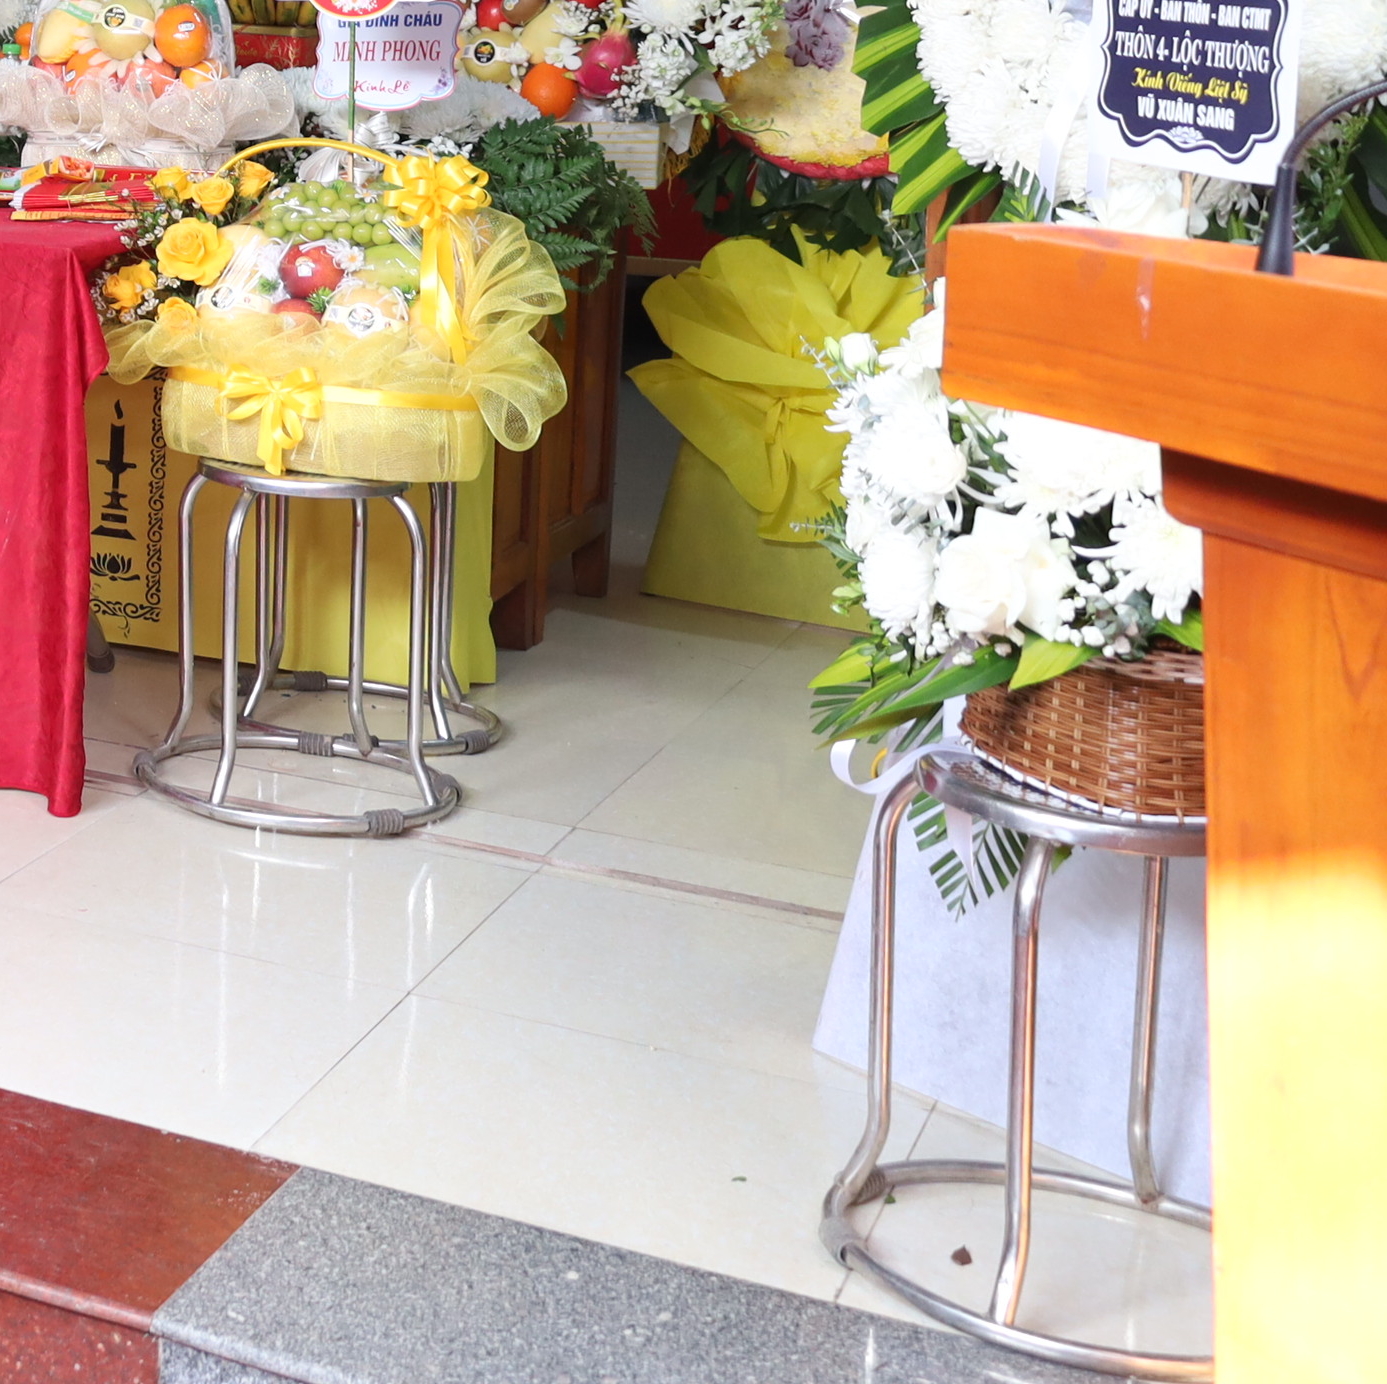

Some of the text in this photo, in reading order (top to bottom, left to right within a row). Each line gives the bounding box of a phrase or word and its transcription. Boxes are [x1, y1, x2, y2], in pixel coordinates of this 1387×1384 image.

[404, 10, 443, 27] CHÁU
[1160, 0, 1182, 22] BAN
[1217, 4, 1241, 29] BAN
[1241, 7, 1272, 31] CTMT
[381, 39, 441, 62] PHONG
[1115, 24, 1156, 59] THÔN
[1171, 29, 1202, 72] LỘC
[1204, 39, 1270, 78] THƯỢNG
[1131, 67, 1163, 91] Kính
[1165, 71, 1203, 99] Viếng
[1203, 76, 1230, 104] Liệt
[1137, 93, 1235, 131] VŨ XUÂN SANG
